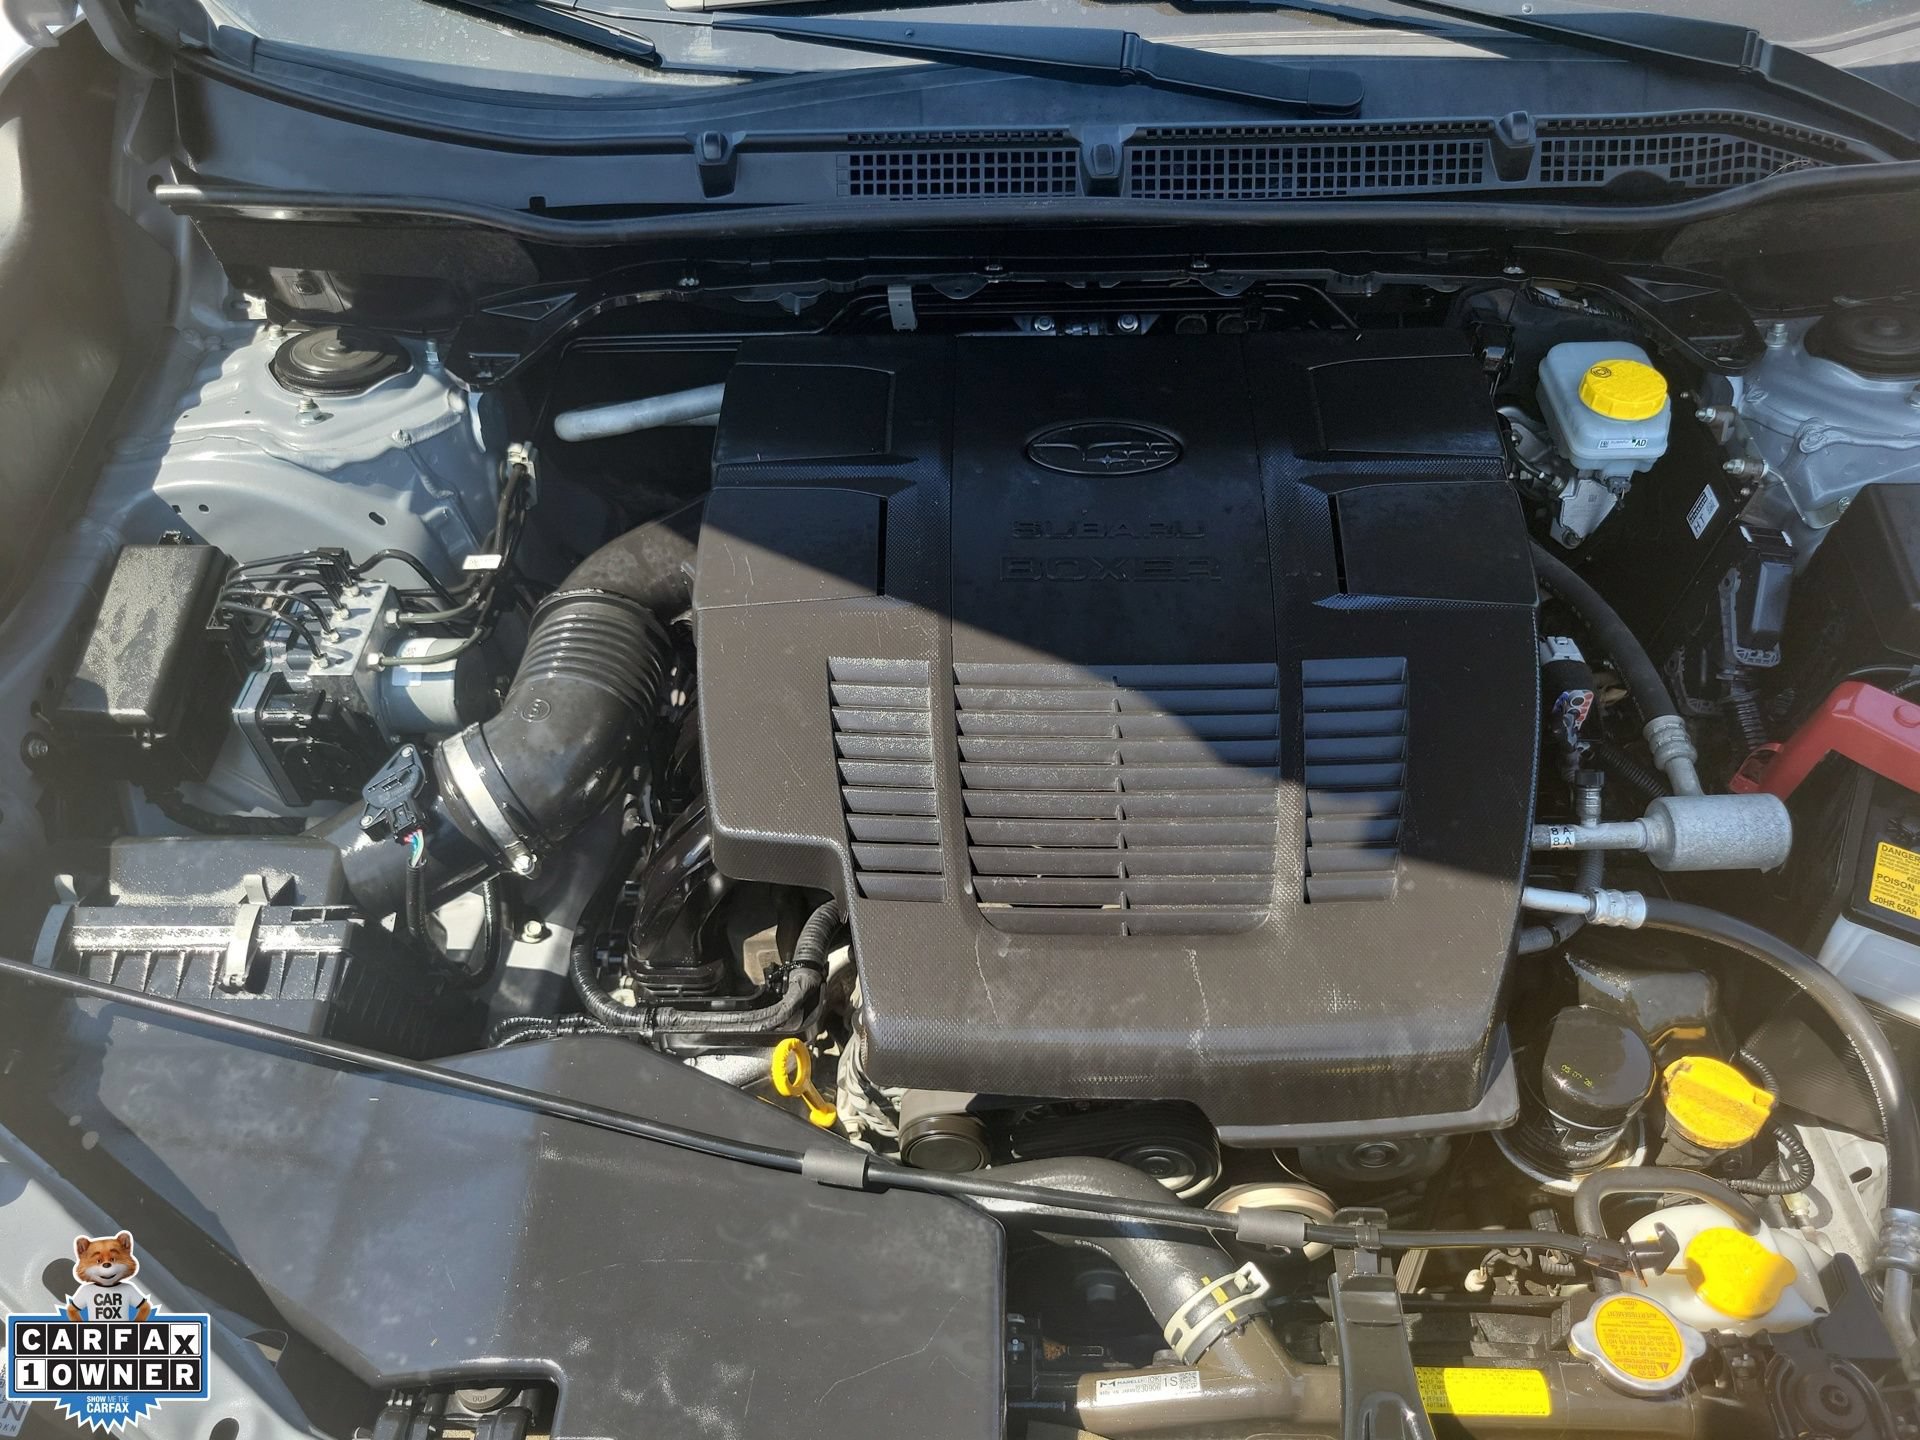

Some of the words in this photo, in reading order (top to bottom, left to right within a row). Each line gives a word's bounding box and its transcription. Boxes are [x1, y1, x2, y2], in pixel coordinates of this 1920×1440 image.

[1011, 520, 1205, 539] SUBARU
[999, 556, 1222, 582] BOXER
[1881, 844, 1920, 863] DANGER
[1876, 873, 1915, 892] POISON
[1873, 895, 1895, 909] 20HR
